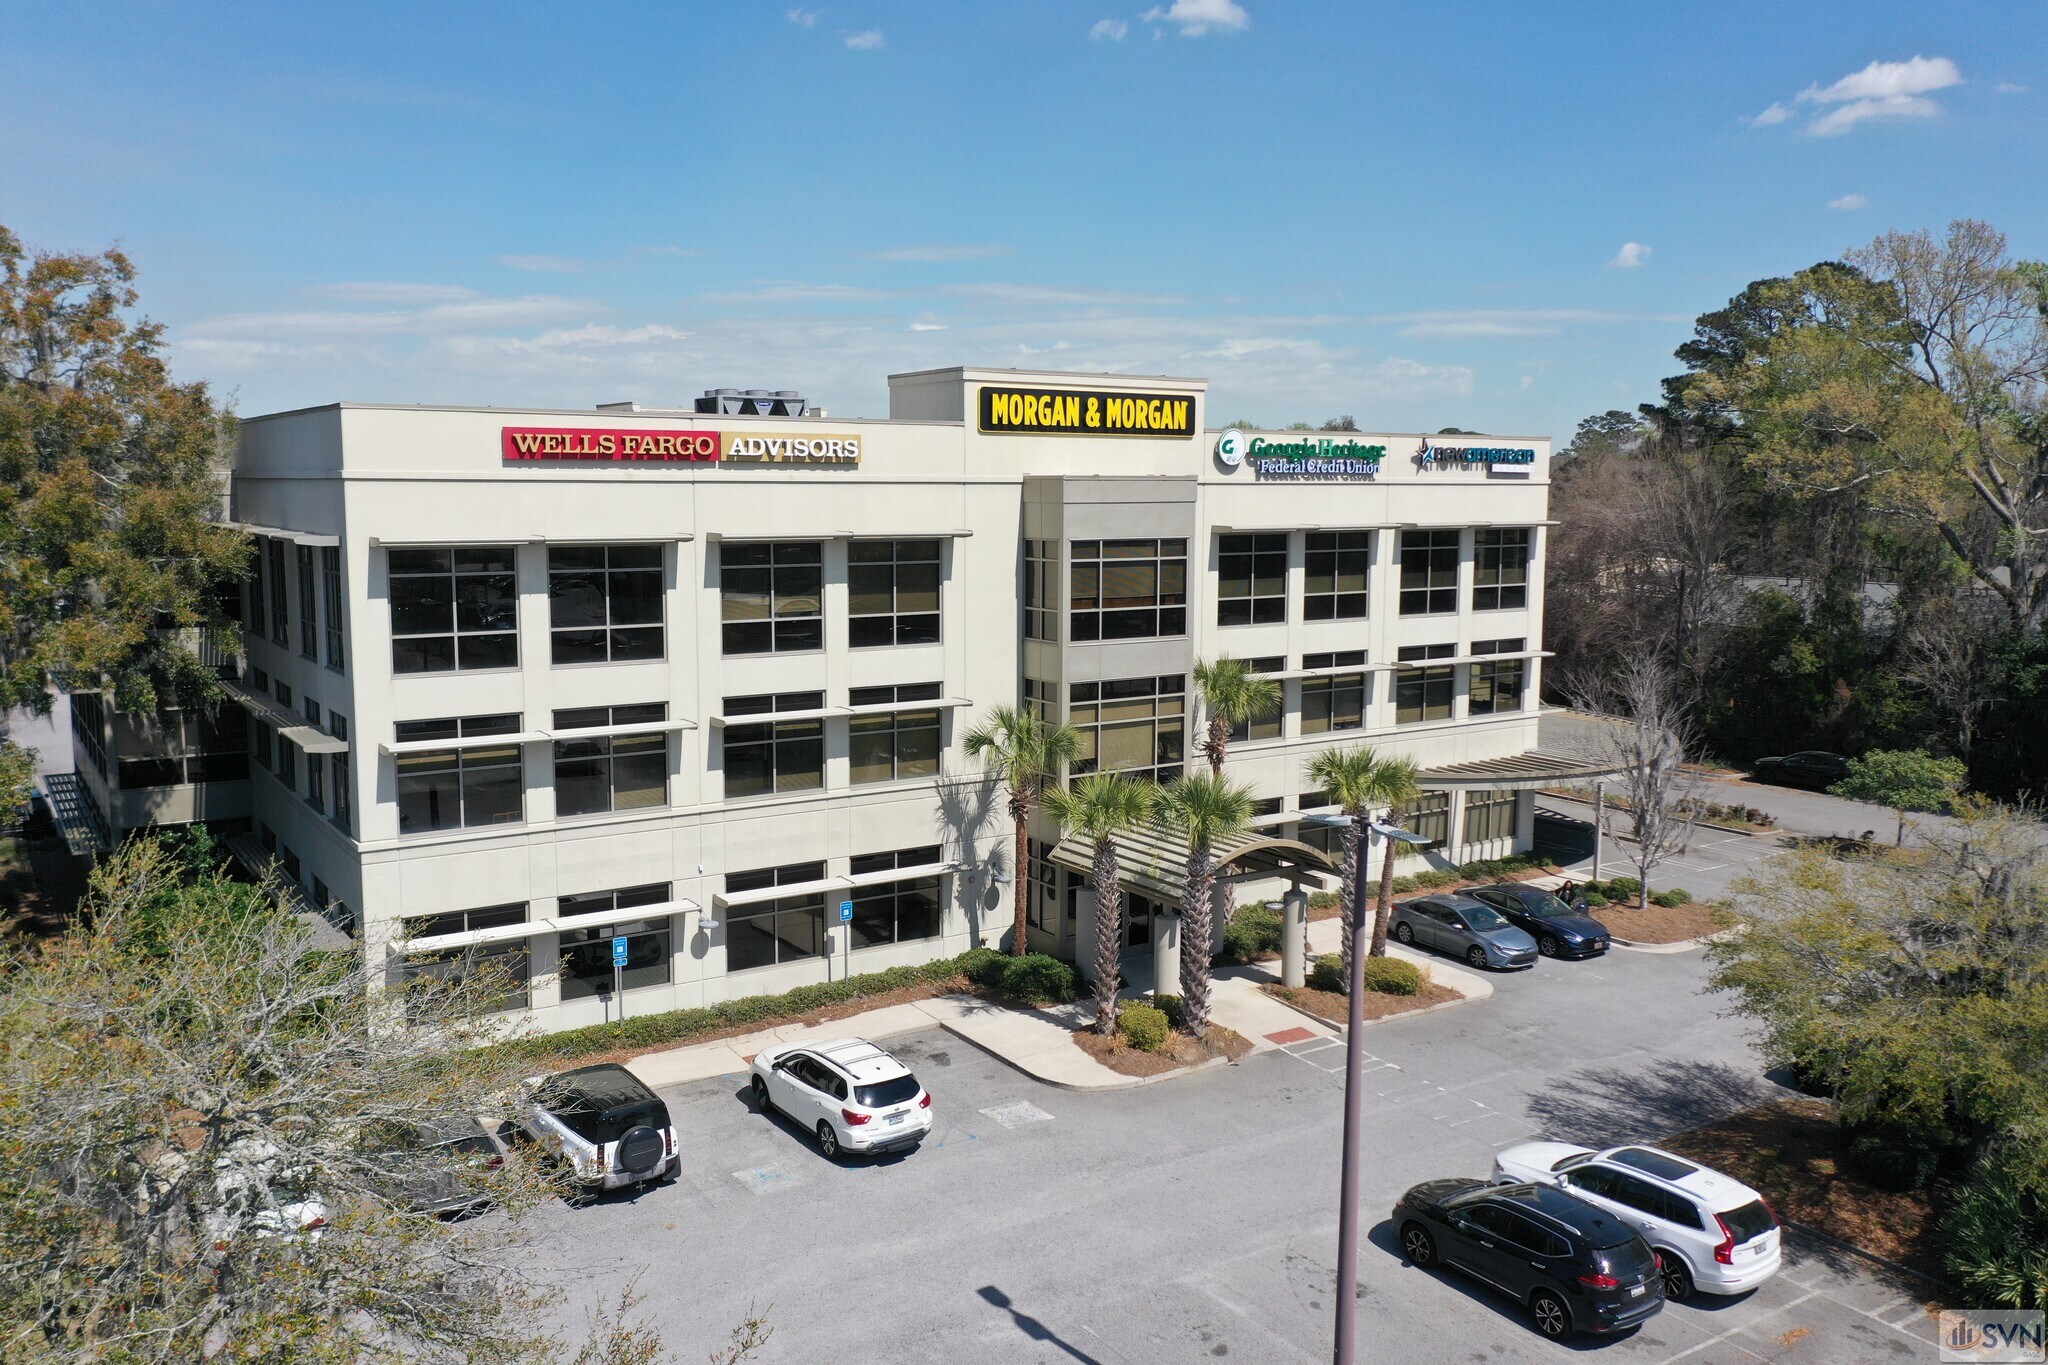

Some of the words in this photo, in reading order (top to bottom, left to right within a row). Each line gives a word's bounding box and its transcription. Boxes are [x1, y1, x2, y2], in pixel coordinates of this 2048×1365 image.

[991, 393, 1080, 427] MORGAN
[1085, 397, 1101, 428] &
[1106, 398, 1187, 430] MORGAN
[513, 433, 616, 454] WELLS
[622, 435, 715, 456] FARGO
[728, 437, 859, 458] ADVISORS
[1251, 437, 1318, 461] Georgia
[1318, 438, 1387, 463] Heritage
[1260, 459, 1305, 474] Federal
[1307, 459, 1345, 474] Credit
[1346, 459, 1381, 475] Union
